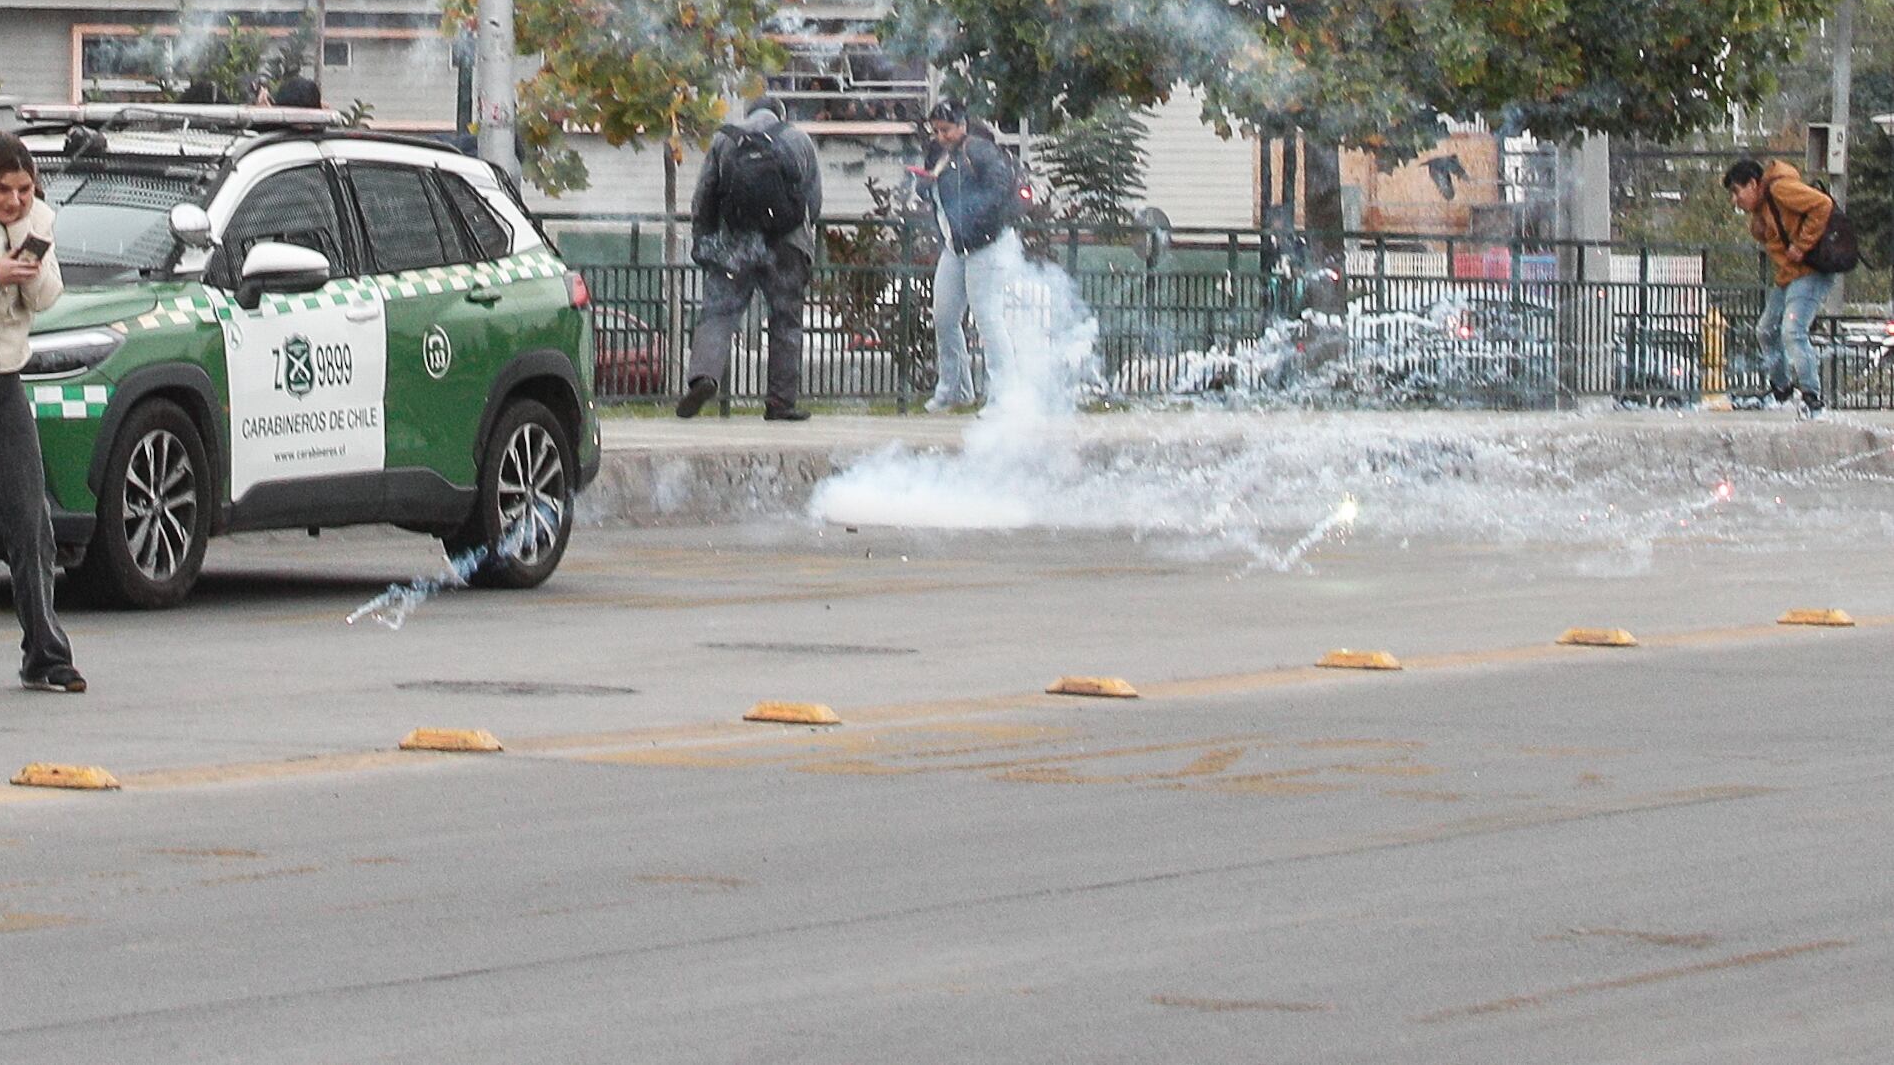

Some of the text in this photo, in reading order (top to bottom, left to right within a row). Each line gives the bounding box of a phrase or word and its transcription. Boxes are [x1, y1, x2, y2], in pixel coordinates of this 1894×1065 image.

[272, 342, 353, 391] Z 9899
[242, 407, 378, 439] CARABINEROS DE CHILE
